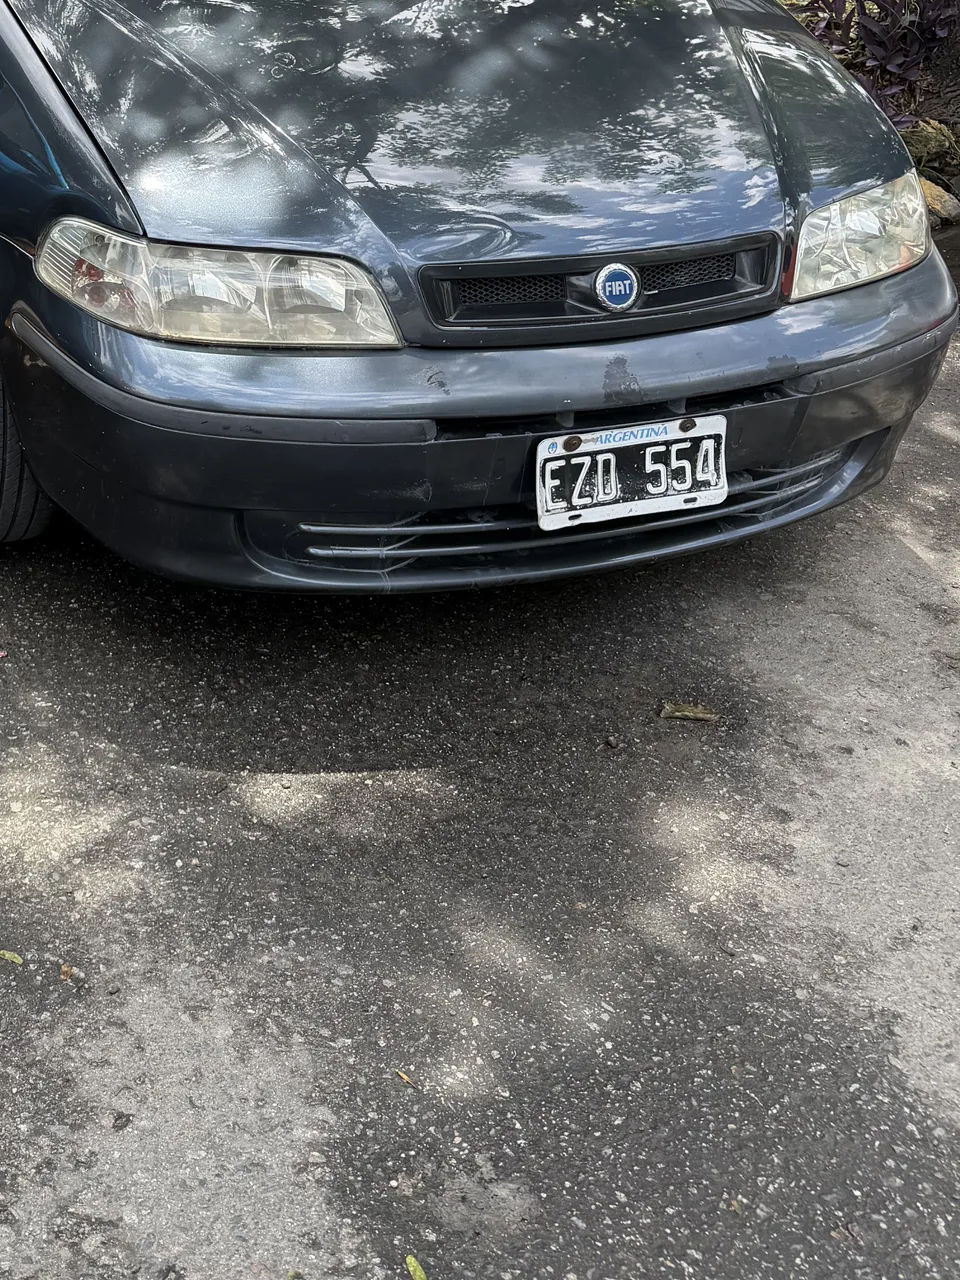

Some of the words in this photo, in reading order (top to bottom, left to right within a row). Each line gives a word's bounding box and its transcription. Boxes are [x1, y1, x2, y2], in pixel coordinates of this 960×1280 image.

[604, 278, 632, 297] FIAT
[595, 423, 669, 446] ARGENTINA
[544, 452, 617, 510] EZD
[644, 438, 718, 495] 554
